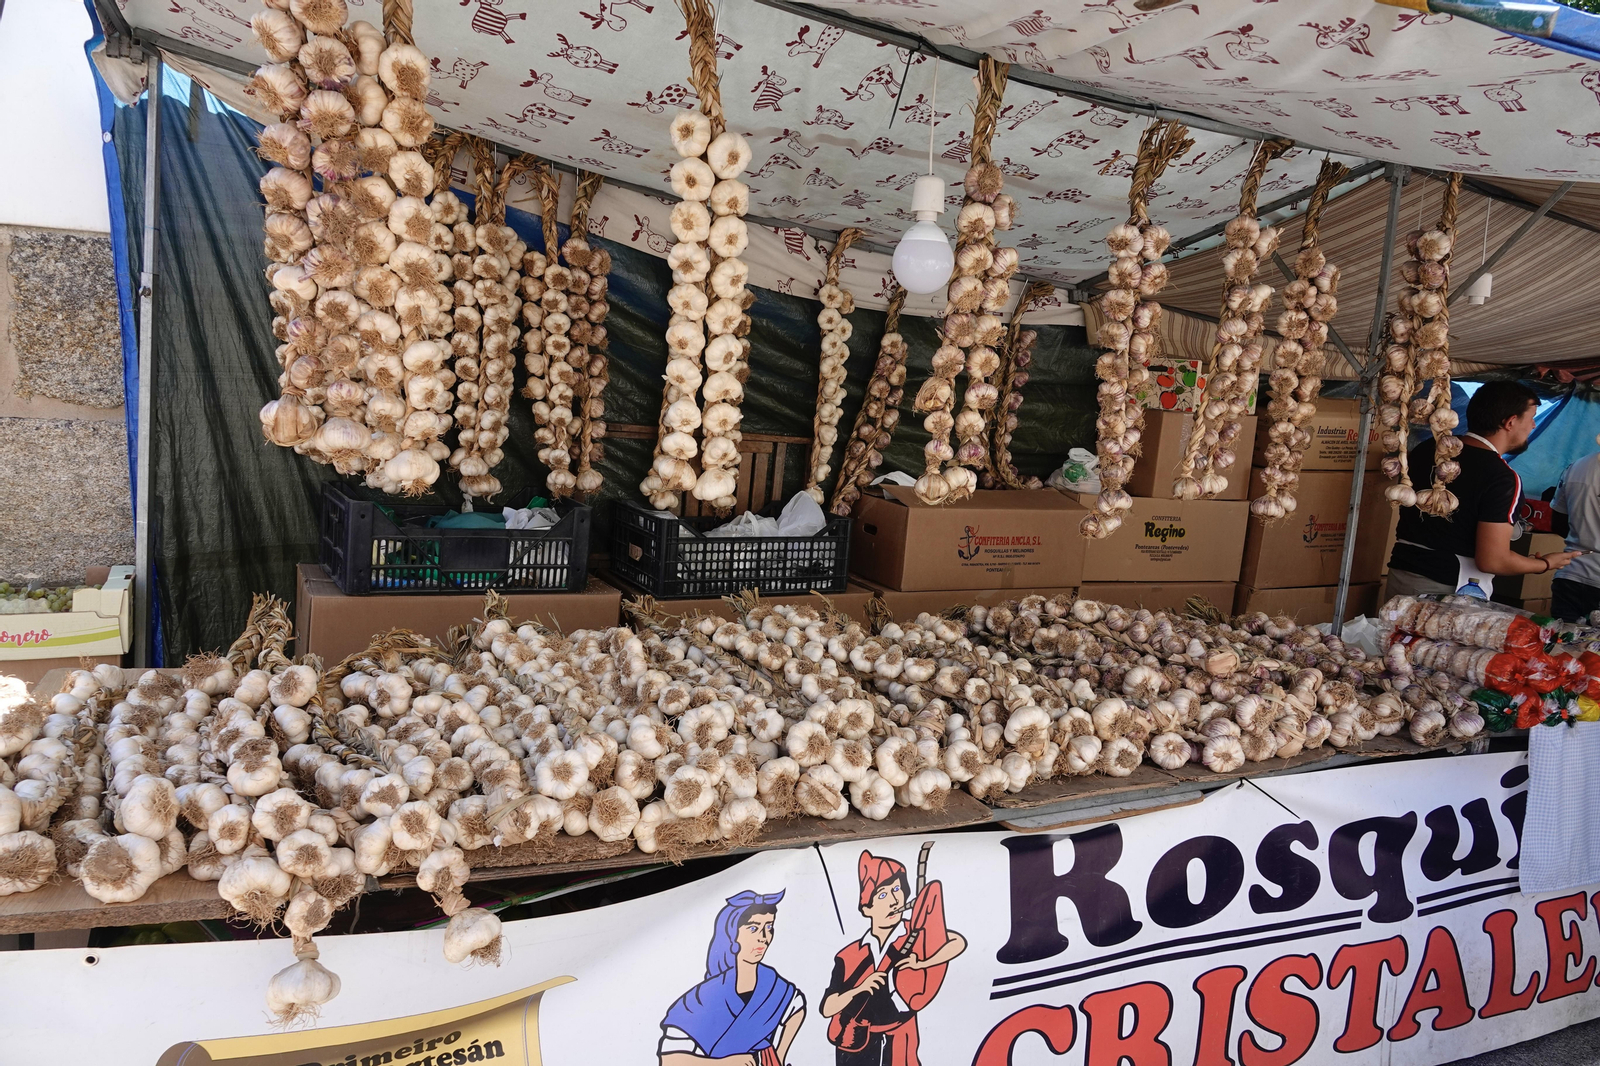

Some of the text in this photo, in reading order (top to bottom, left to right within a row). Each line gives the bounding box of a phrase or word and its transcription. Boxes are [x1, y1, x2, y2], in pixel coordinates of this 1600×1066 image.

[1317, 425, 1379, 441] Industrias Rello
[974, 536, 1009, 546] CONFITERIA
[1144, 521, 1186, 543] Regino
[996, 765, 1529, 964] Rosqui
[972, 891, 1600, 1066] CRISTALE
